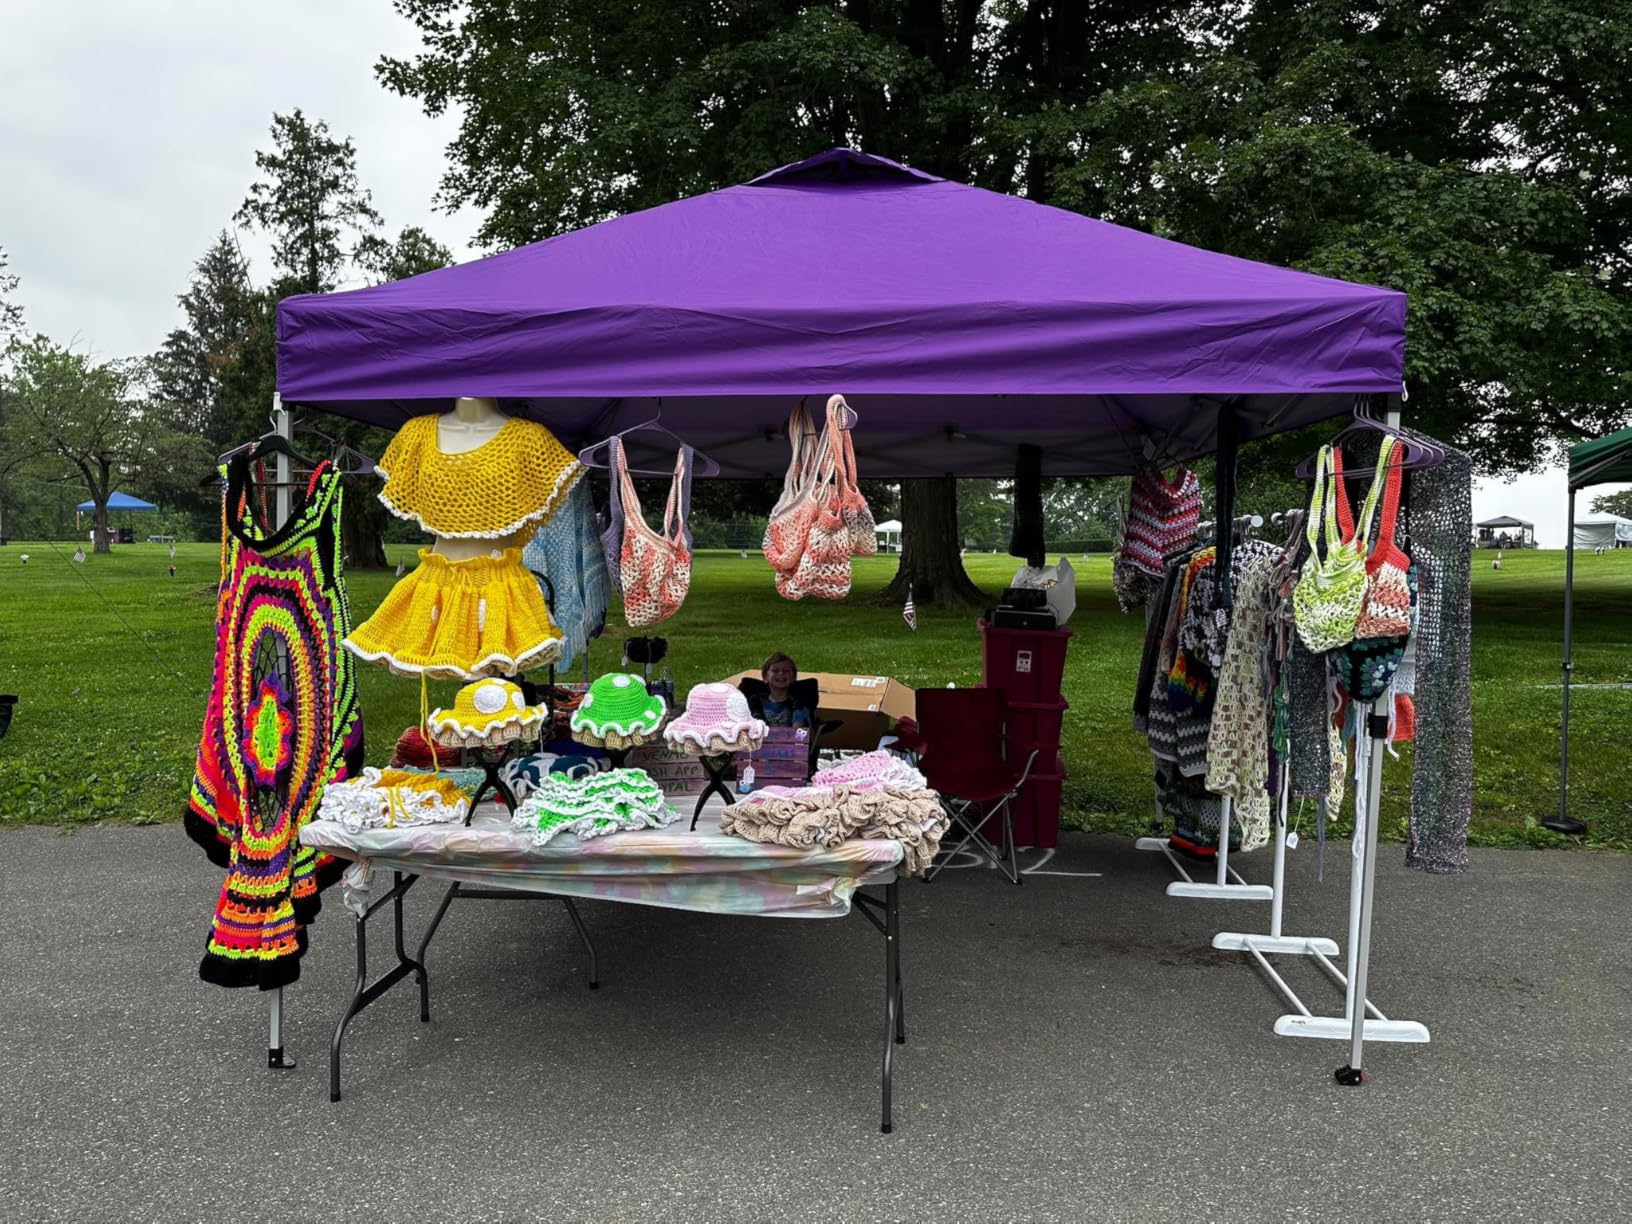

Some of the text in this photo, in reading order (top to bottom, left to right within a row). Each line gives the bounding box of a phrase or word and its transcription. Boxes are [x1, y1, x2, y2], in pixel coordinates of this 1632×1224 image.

[642, 750, 688, 760] VENMO
[674, 766, 698, 777] APP
[659, 782, 694, 793] YPAL
